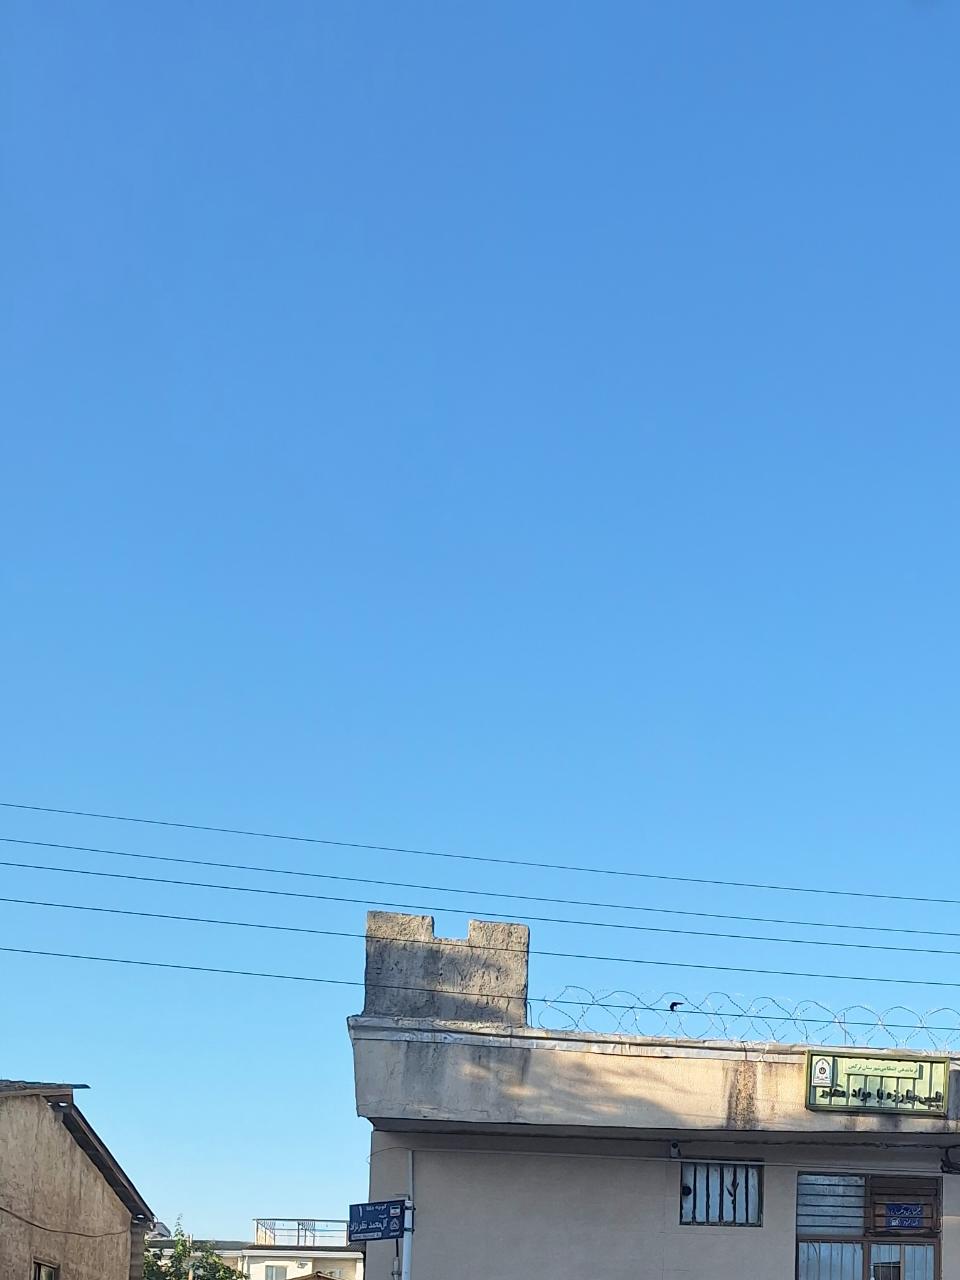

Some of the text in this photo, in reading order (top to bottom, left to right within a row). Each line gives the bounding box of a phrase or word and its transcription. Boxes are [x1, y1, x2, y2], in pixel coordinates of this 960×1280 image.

[819, 1084, 846, 1099] مخدر
[851, 1087, 872, 1102] مواد
[876, 1088, 884, 1103] با
[886, 1089, 919, 1104] مبارزه
